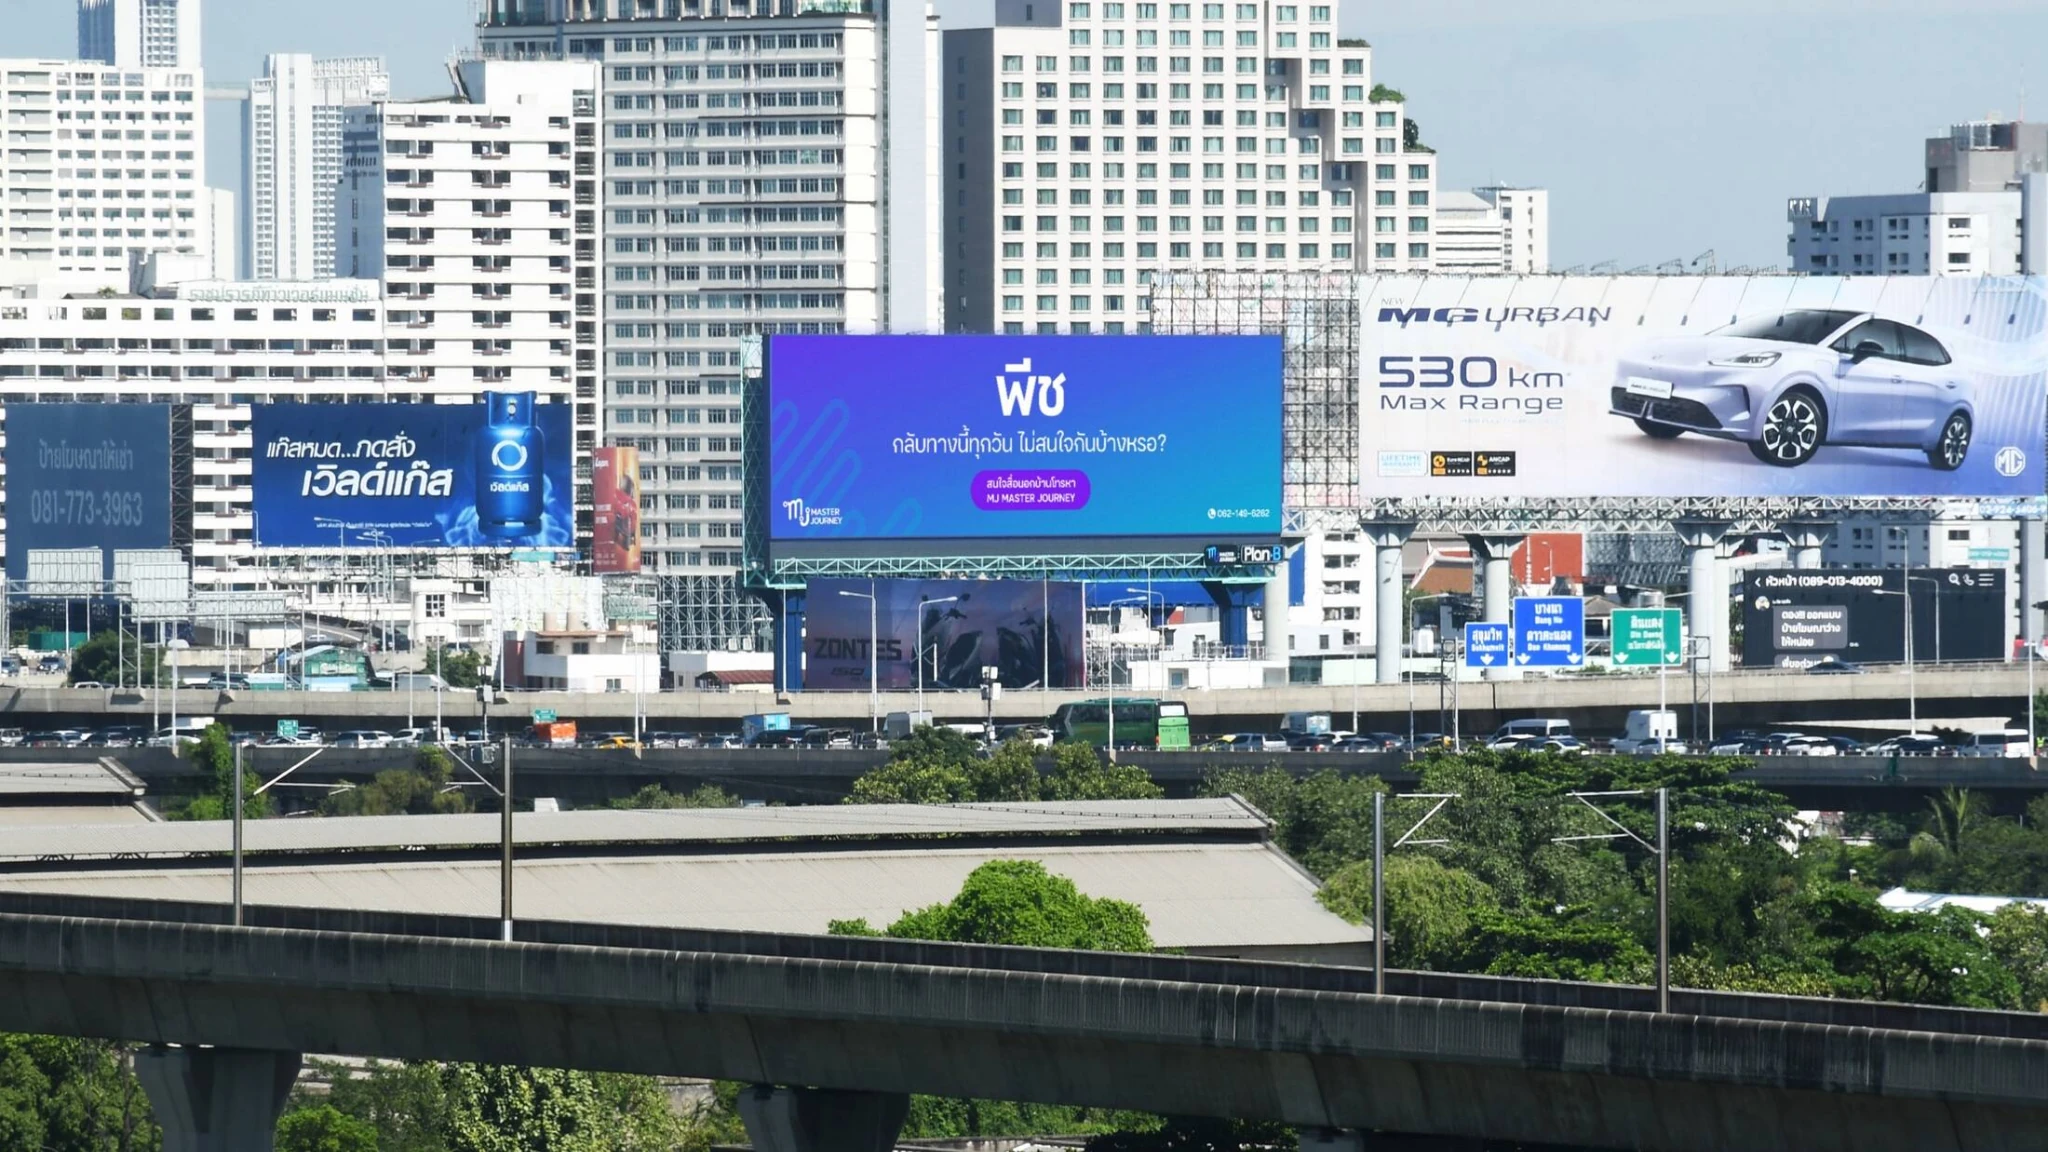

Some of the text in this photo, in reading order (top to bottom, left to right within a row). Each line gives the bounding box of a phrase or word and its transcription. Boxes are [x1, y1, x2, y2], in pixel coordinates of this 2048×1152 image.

[1378, 307, 1612, 322] MG URBAN
[1379, 356, 1563, 387] 530 km
[996, 358, 1067, 417] พีช
[1381, 395, 1563, 414] Max Range
[892, 425, 1167, 460] กลับทางนี้ทุกวัน ไม่สนใจกันบ้างหรอ?
[1998, 450, 2023, 474] MG
[302, 461, 453, 496] เวิลด์แก๊ส
[31, 489, 143, 526] 081-773-3963
[986, 493, 1076, 503] MJ MASTER JOURNEY
[810, 508, 840, 516] MASTER
[810, 516, 843, 525] JOURNEY
[1798, 575, 1883, 587] (089-013-4000)
[814, 639, 902, 660] ZONTES
